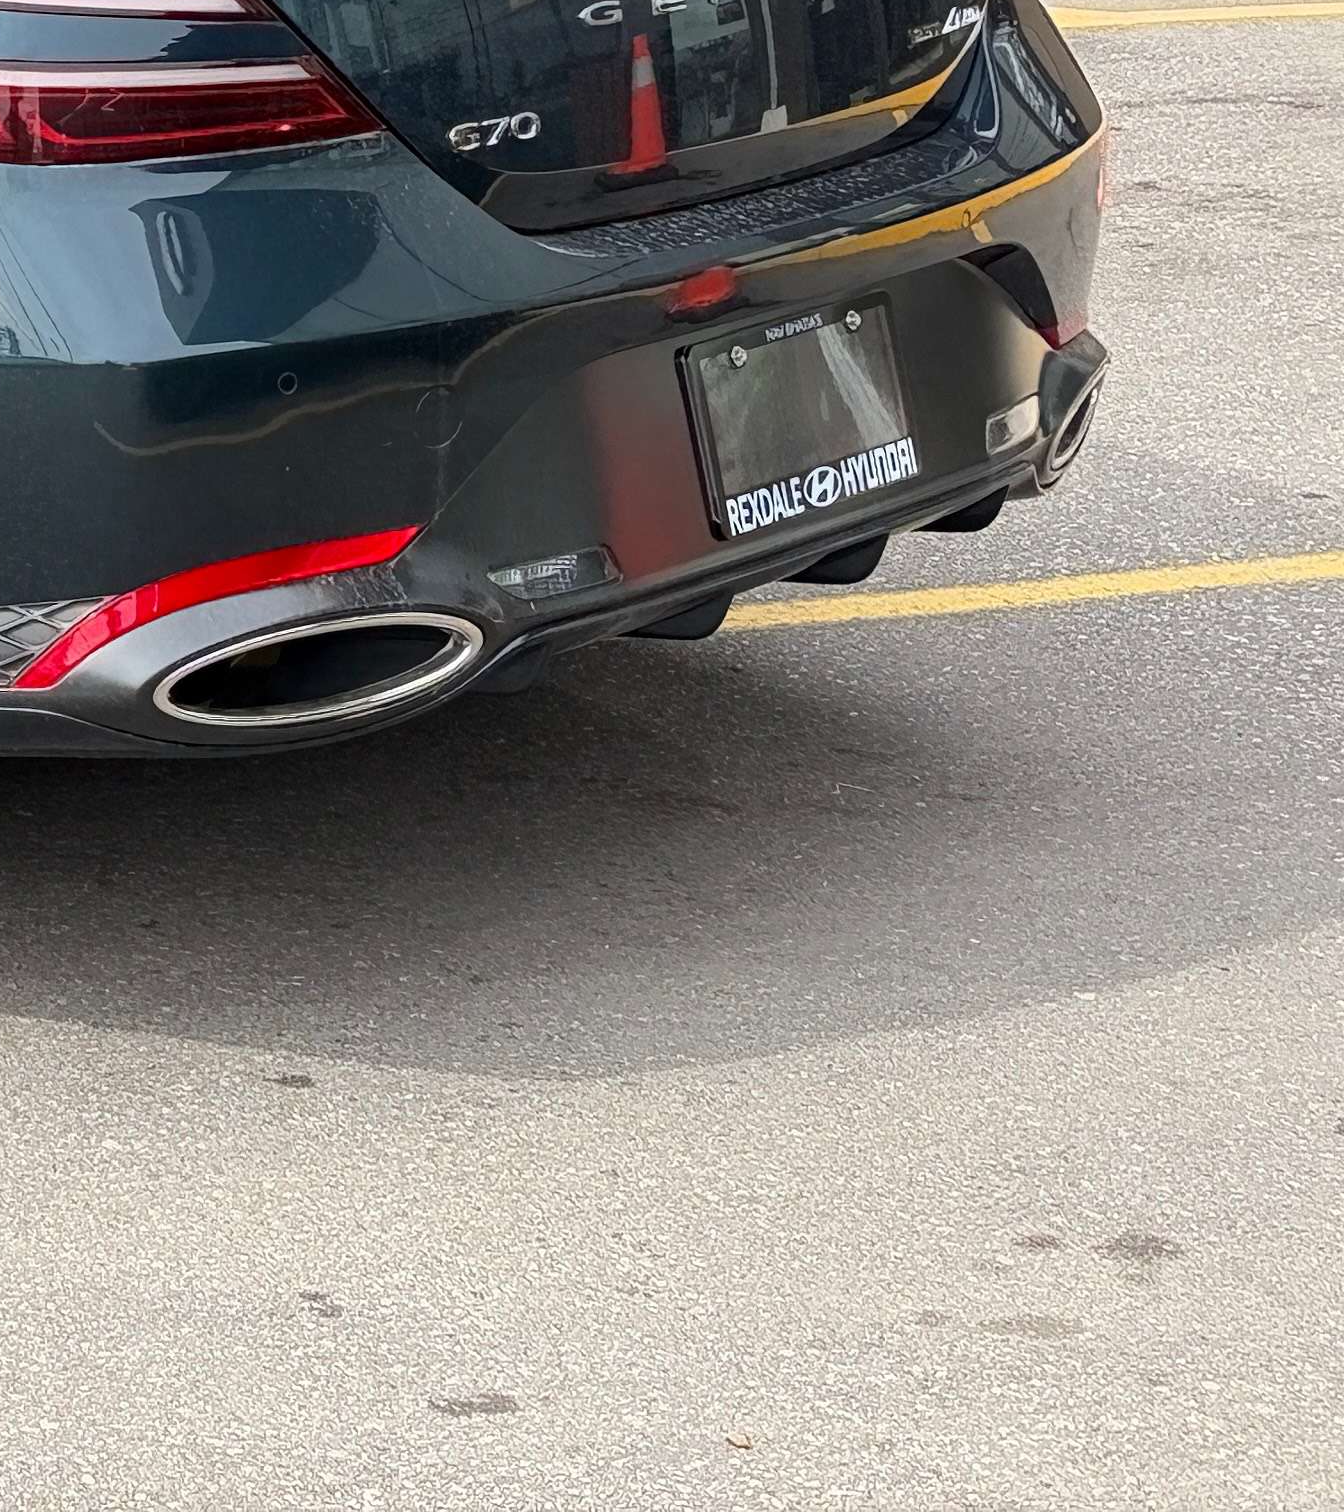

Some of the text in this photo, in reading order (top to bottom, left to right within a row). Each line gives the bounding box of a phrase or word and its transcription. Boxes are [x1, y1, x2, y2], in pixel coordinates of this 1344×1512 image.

[447, 110, 543, 154] G70
[724, 436, 919, 537] REXDALE HYUNDAI
